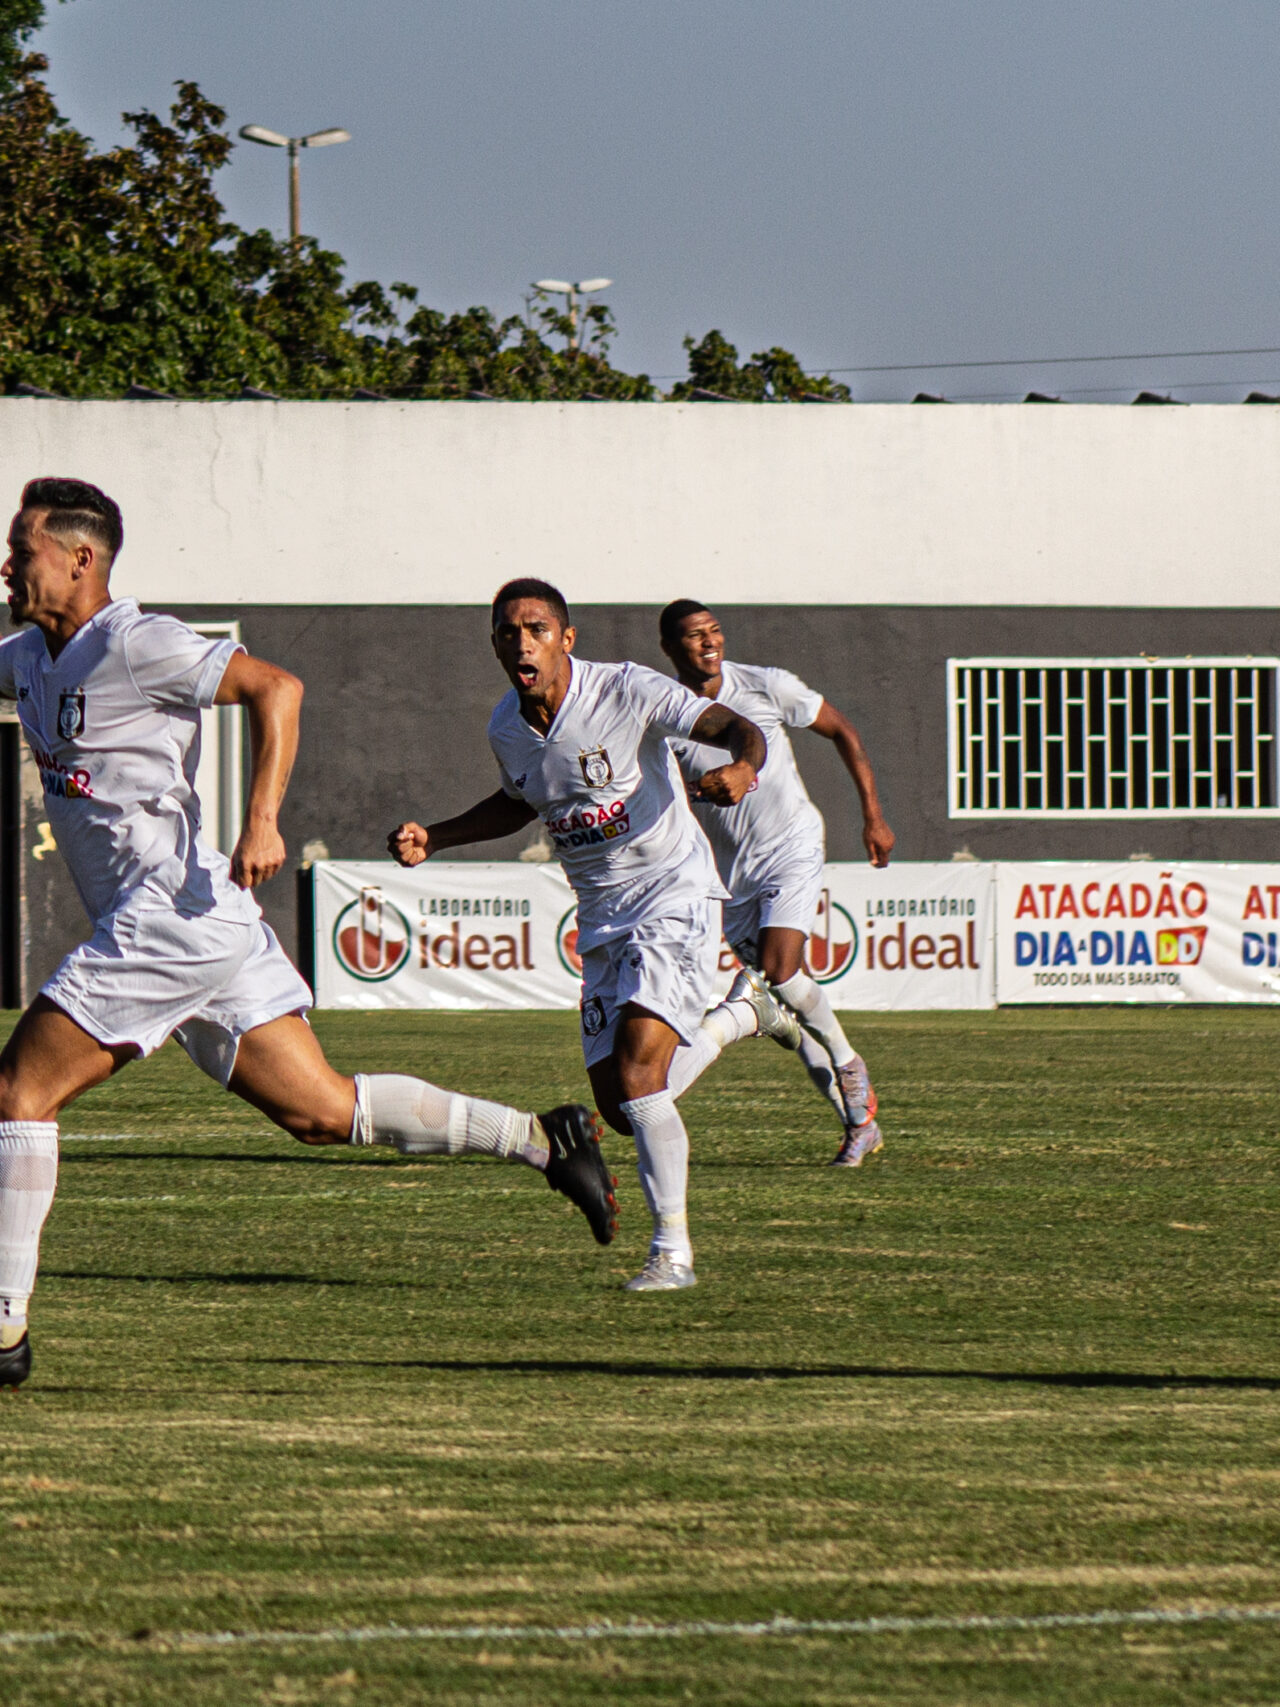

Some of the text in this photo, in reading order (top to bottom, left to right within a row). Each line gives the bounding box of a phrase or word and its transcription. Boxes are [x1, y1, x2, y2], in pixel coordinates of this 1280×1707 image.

[419, 896, 531, 917] LABORATÓRIO
[866, 896, 976, 917] LABORATÓRIO
[1014, 872, 1208, 919] ATACADÃO
[419, 920, 535, 970] ideal
[866, 920, 980, 970] ideal
[1033, 972, 1068, 986] TODO
[1071, 972, 1092, 986] DIA
[1094, 972, 1126, 986] MAIS
